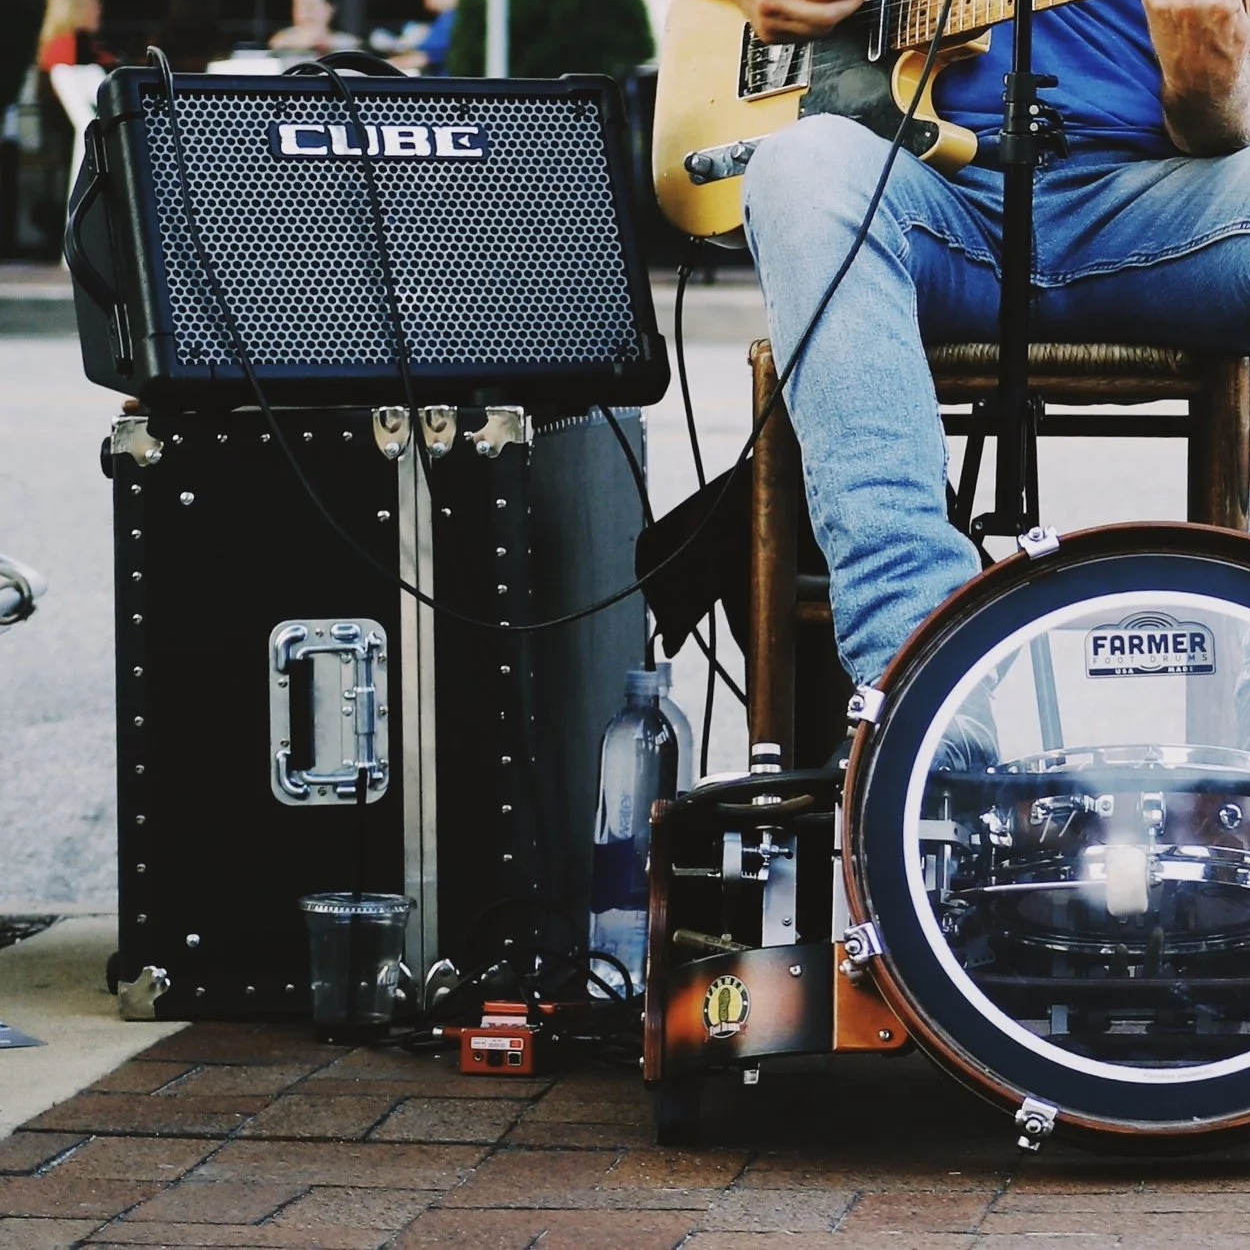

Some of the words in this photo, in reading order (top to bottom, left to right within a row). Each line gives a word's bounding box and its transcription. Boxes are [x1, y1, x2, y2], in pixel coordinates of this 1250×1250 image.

[278, 123, 483, 157] CUBE
[1092, 632, 1207, 656] FARMER
[1092, 655, 1135, 666] FOOT
[1149, 653, 1208, 664] DRUMS
[1114, 667, 1135, 675] USA
